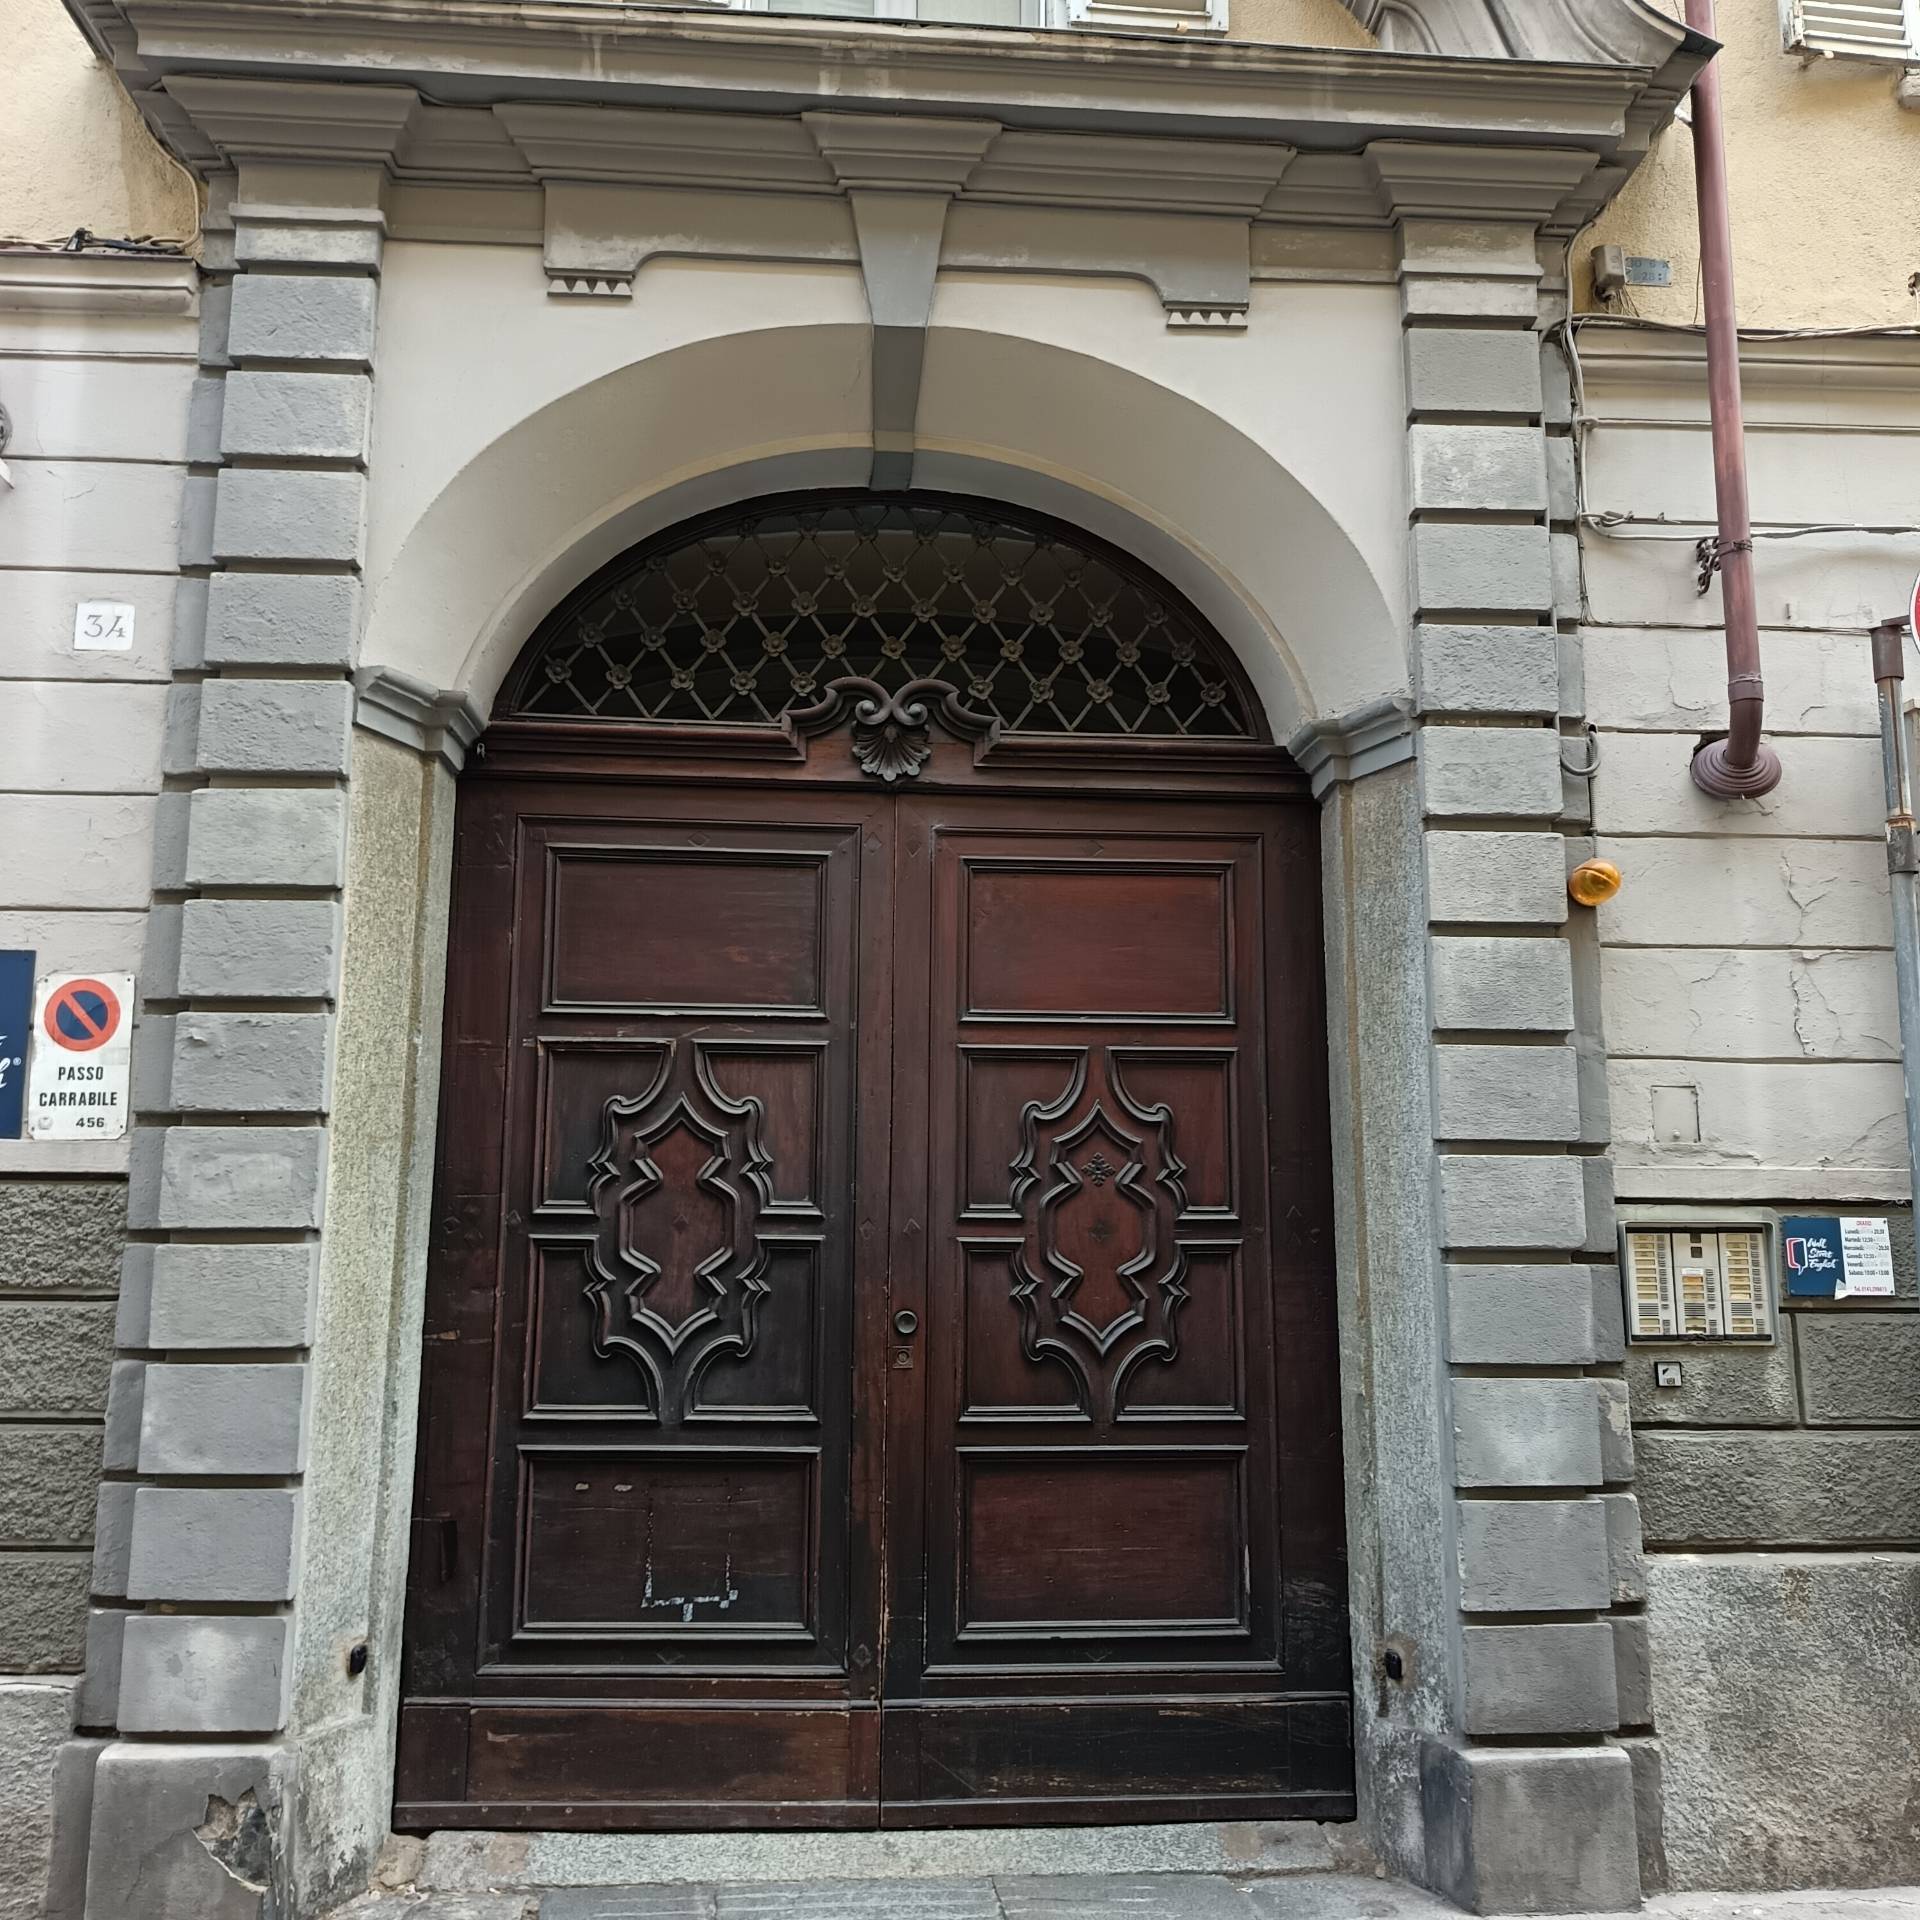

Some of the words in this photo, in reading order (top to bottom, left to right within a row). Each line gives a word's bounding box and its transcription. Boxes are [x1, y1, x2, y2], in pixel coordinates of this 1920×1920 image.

[84, 614, 126, 638] 34
[58, 1066, 104, 1081] PASSO
[39, 1091, 118, 1107] CARRABILE
[75, 1117, 105, 1128] 456
[1807, 1237, 1827, 1248] Wall
[1809, 1248, 1832, 1258] Street
